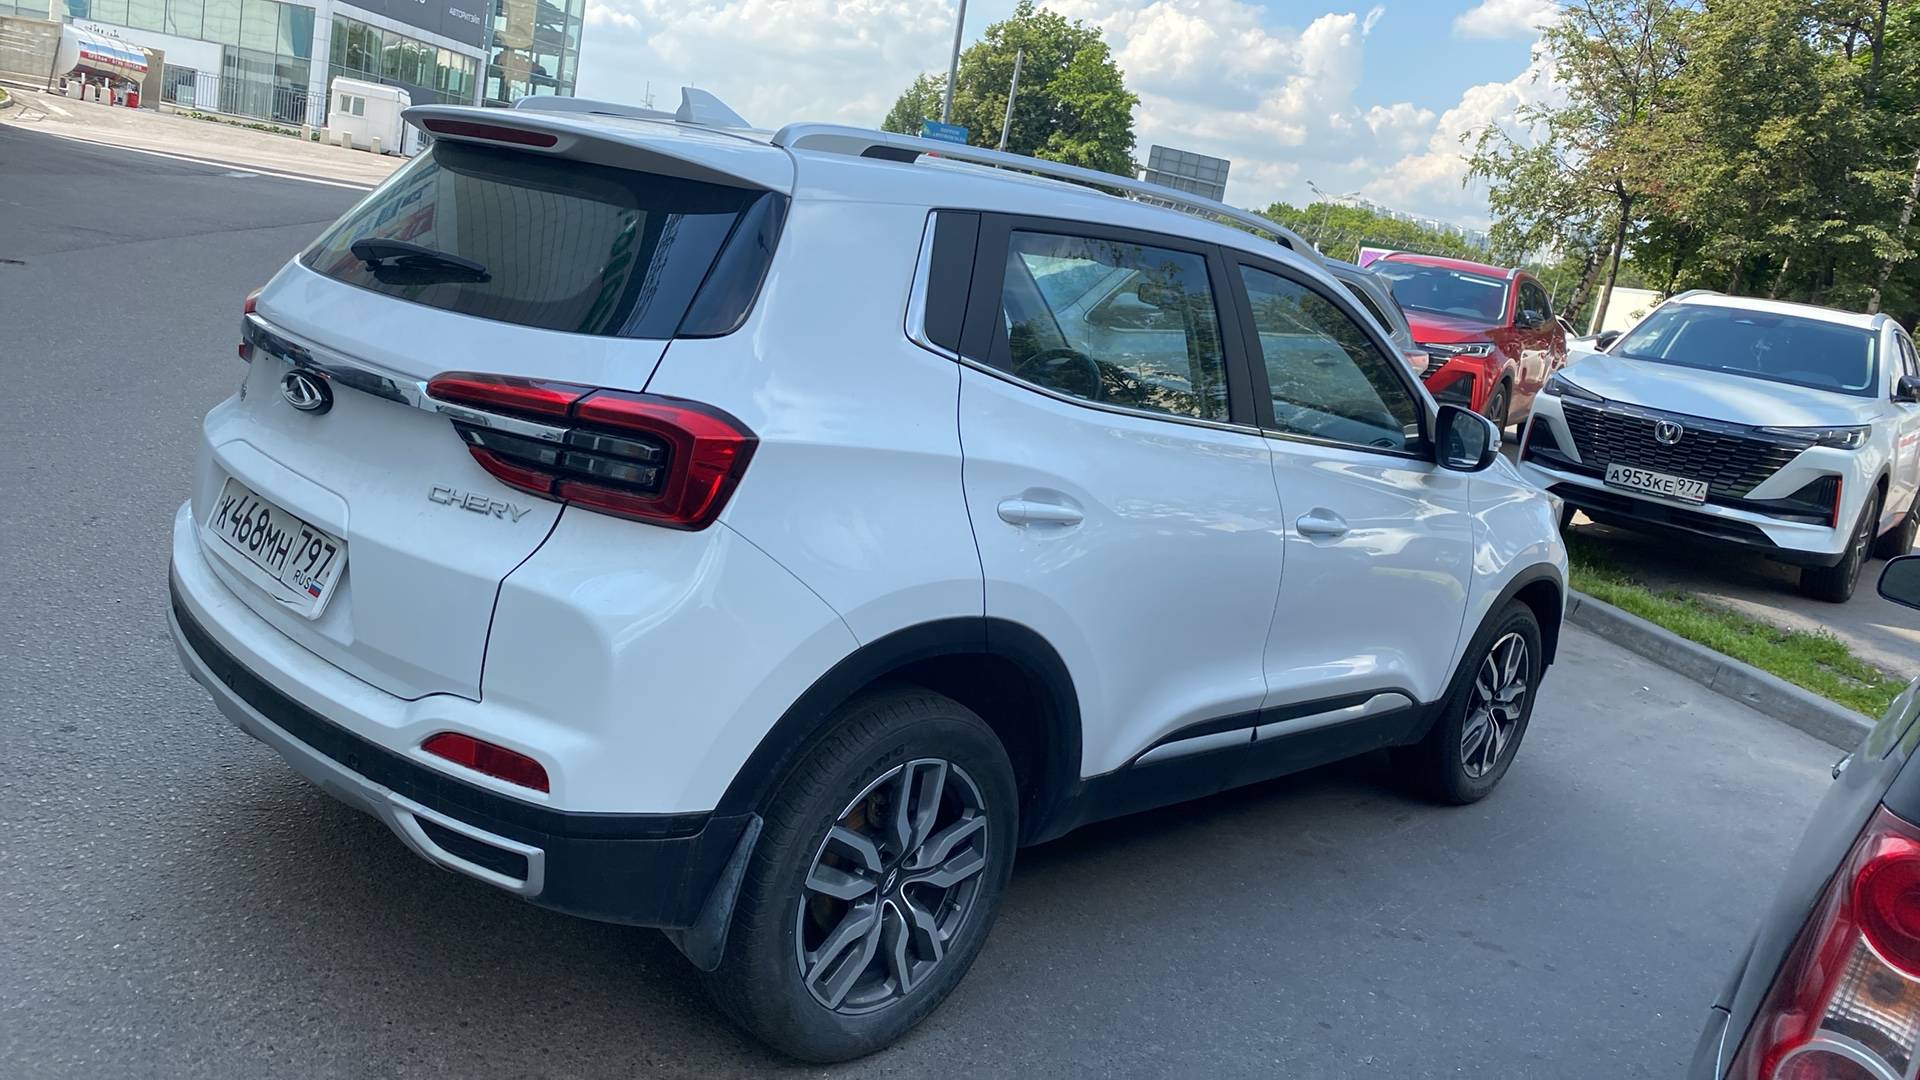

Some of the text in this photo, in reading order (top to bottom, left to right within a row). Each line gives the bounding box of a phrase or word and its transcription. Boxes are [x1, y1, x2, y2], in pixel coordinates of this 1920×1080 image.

[1611, 469, 1702, 493] А953КЕ 977
[428, 485, 533, 523] CHERY
[216, 495, 337, 580] К468МН 797
[294, 569, 312, 590] RUS
